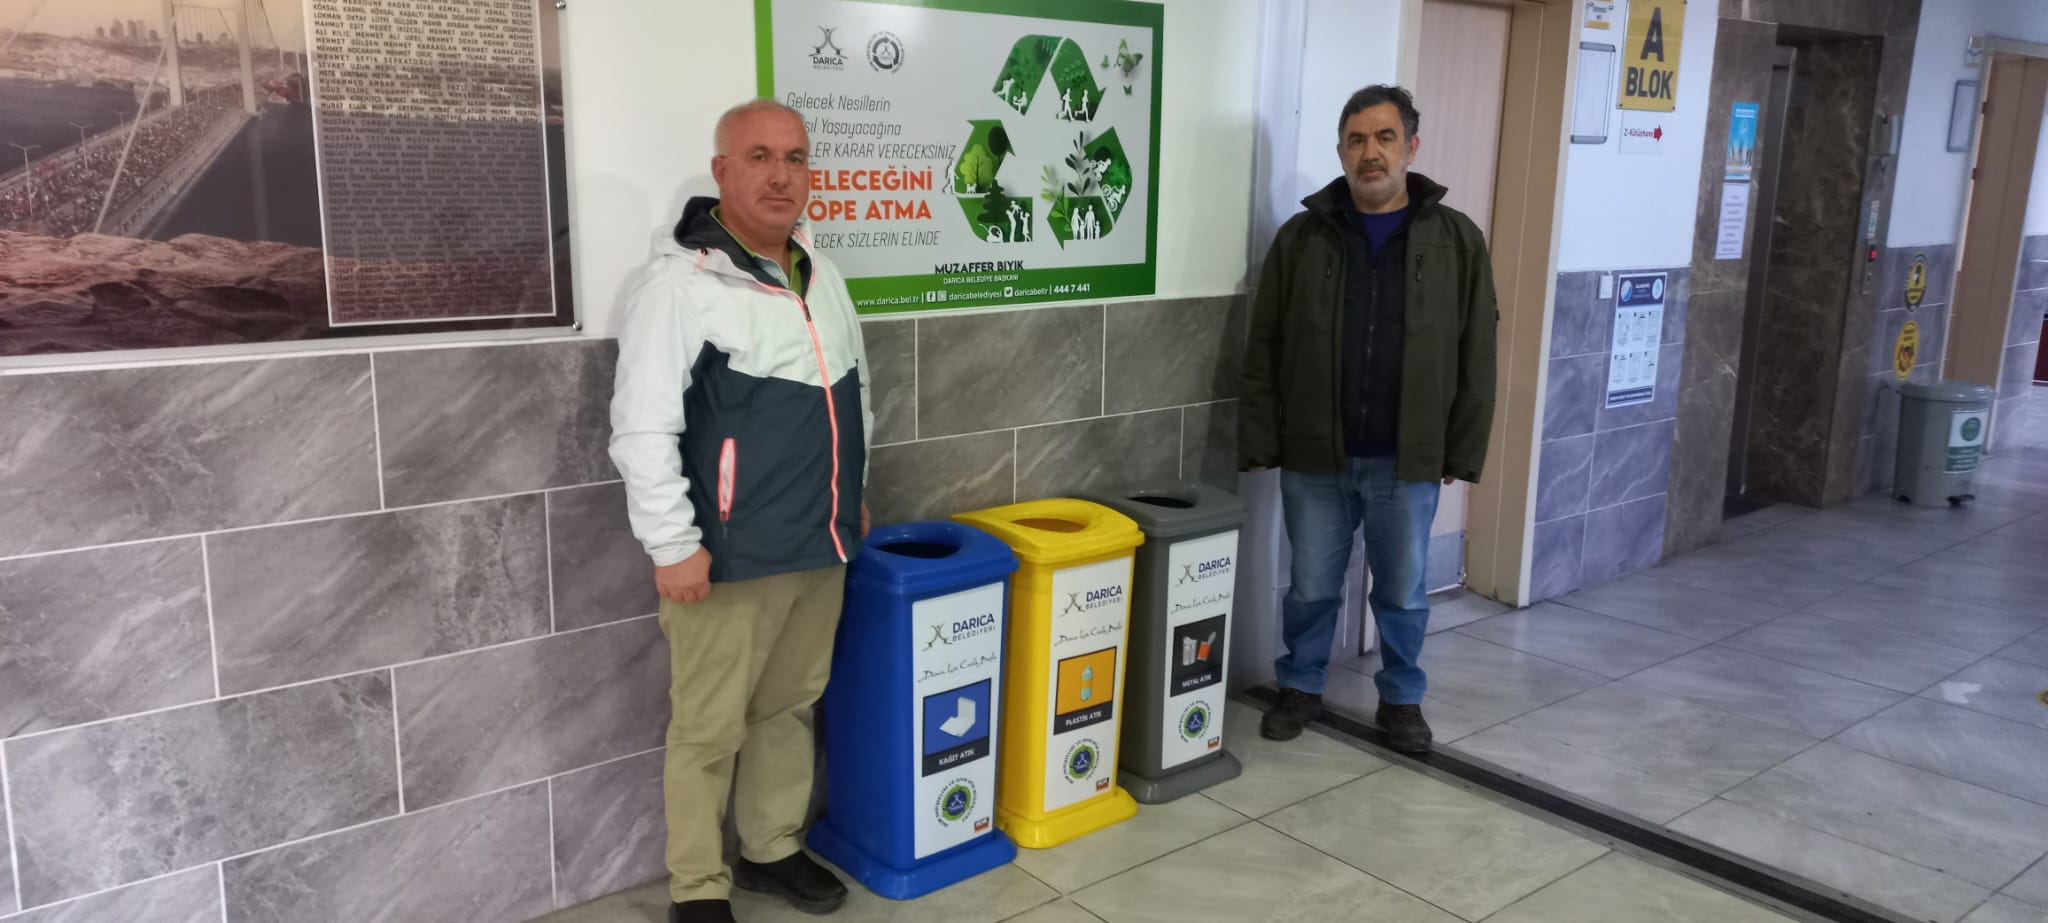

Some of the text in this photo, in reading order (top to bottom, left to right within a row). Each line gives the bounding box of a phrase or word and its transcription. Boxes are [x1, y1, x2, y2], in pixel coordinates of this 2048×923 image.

[1640, 7, 1664, 62] A
[812, 56, 844, 66] DARICA
[1625, 66, 1674, 100] BLOK
[786, 92, 891, 112] Gelecek Nesillerin
[821, 118, 902, 139] Yaşayacağına
[834, 142, 875, 158] KARAR
[877, 142, 956, 160] VERECEKSİNİZ
[809, 165, 933, 190] ELECEĞİNİ
[807, 195, 932, 222] ÖPE ATMA
[847, 229, 900, 248] SİZLERİN
[901, 228, 942, 246] ELİNDE
[935, 260, 1024, 274] MUZAFFER BIYIK
[943, 276, 966, 284] DARICA
[856, 296, 919, 307] www.darica.bel.tr
[1053, 285, 1071, 294] 444
[1077, 284, 1091, 292] 441
[1198, 556, 1231, 572] DARICA
[1086, 585, 1122, 602] DARICA
[953, 613, 995, 634] DARICA
[1182, 678, 1199, 688] METAL
[939, 754, 959, 766] KAĞIT
